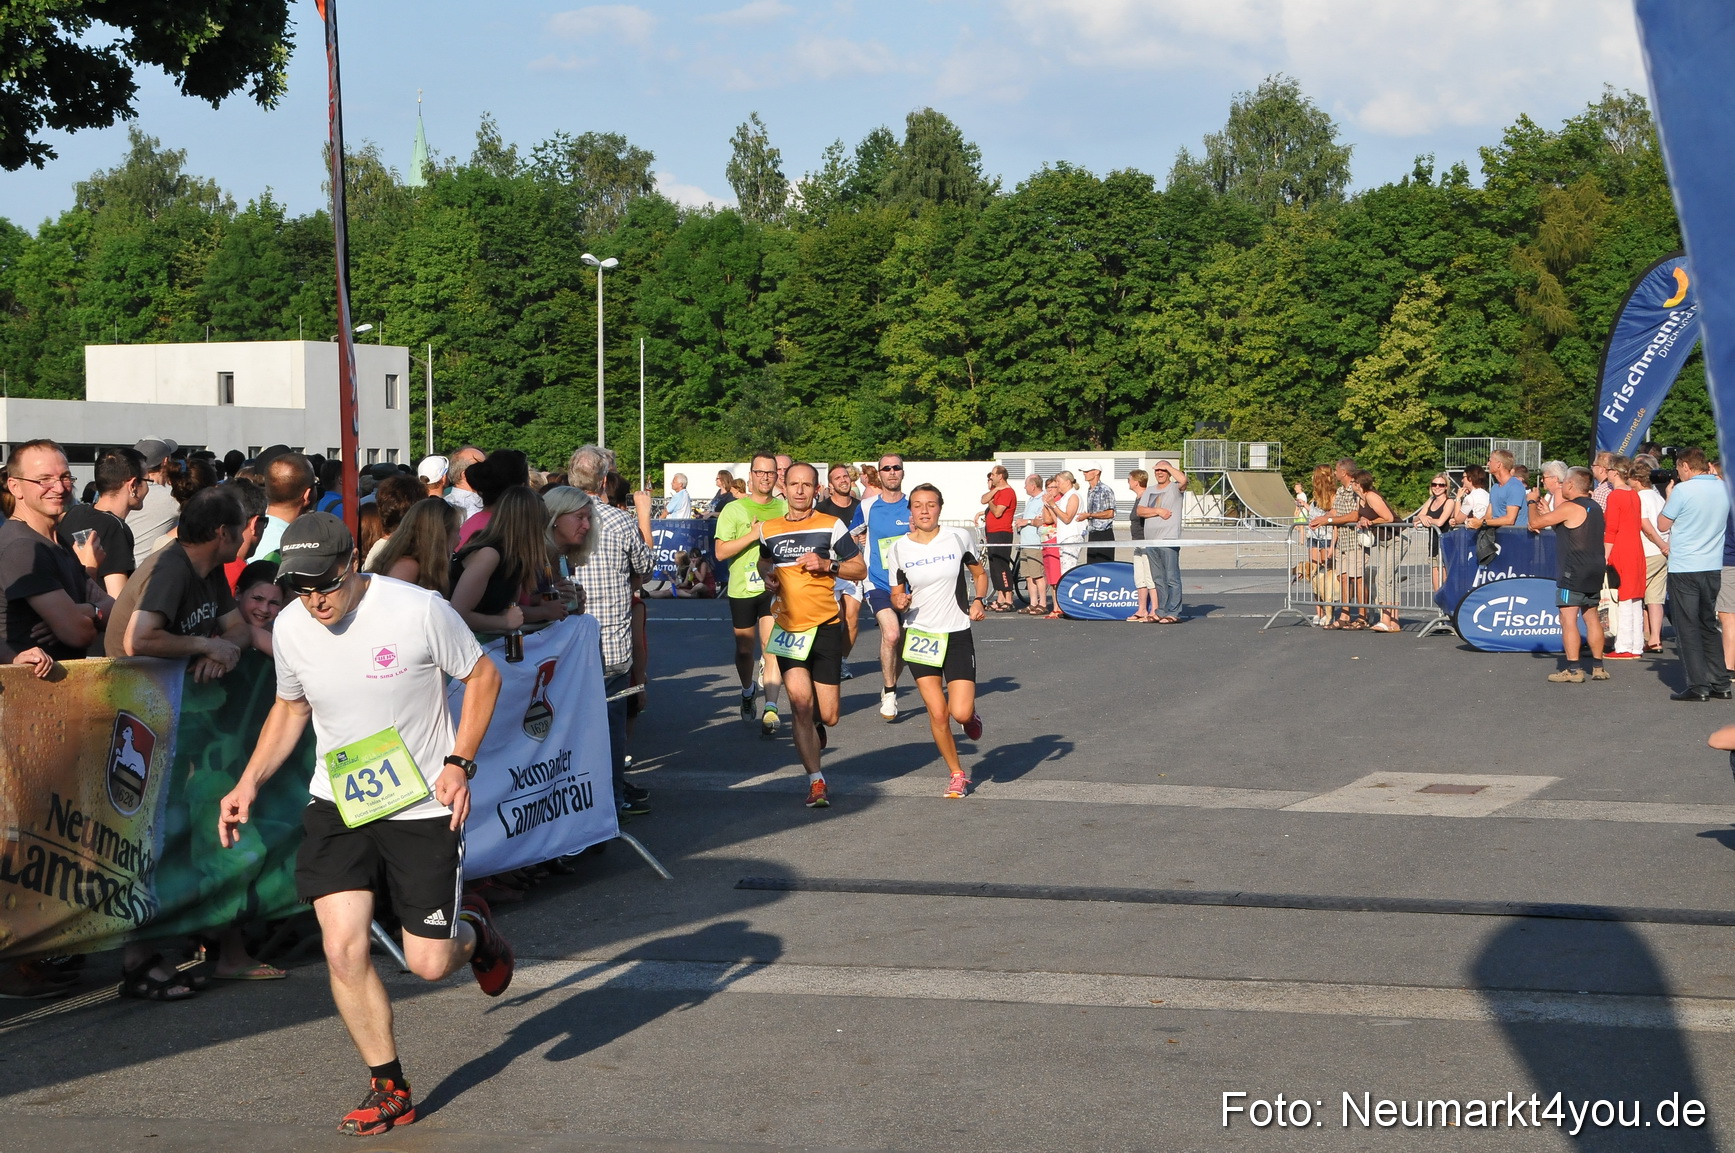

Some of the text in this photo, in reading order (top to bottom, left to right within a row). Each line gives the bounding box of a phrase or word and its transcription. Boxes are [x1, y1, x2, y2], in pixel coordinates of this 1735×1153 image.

[1617, 407, 1646, 456] mann-net.de
[779, 543, 816, 555] Fischer
[653, 564, 678, 572] AUTOM
[905, 554, 956, 569] DELPHI
[1083, 587, 1139, 602] Fische
[1492, 610, 1562, 627] Fisch
[774, 631, 805, 650] 404
[1501, 628, 1563, 636] AUTOMOBI
[909, 636, 939, 656] 224
[531, 720, 550, 737] 1628
[344, 758, 402, 803] 431
[115, 785, 135, 809] 1628
[496, 775, 594, 839] Lammsbräu
[423, 918, 447, 926] adidas
